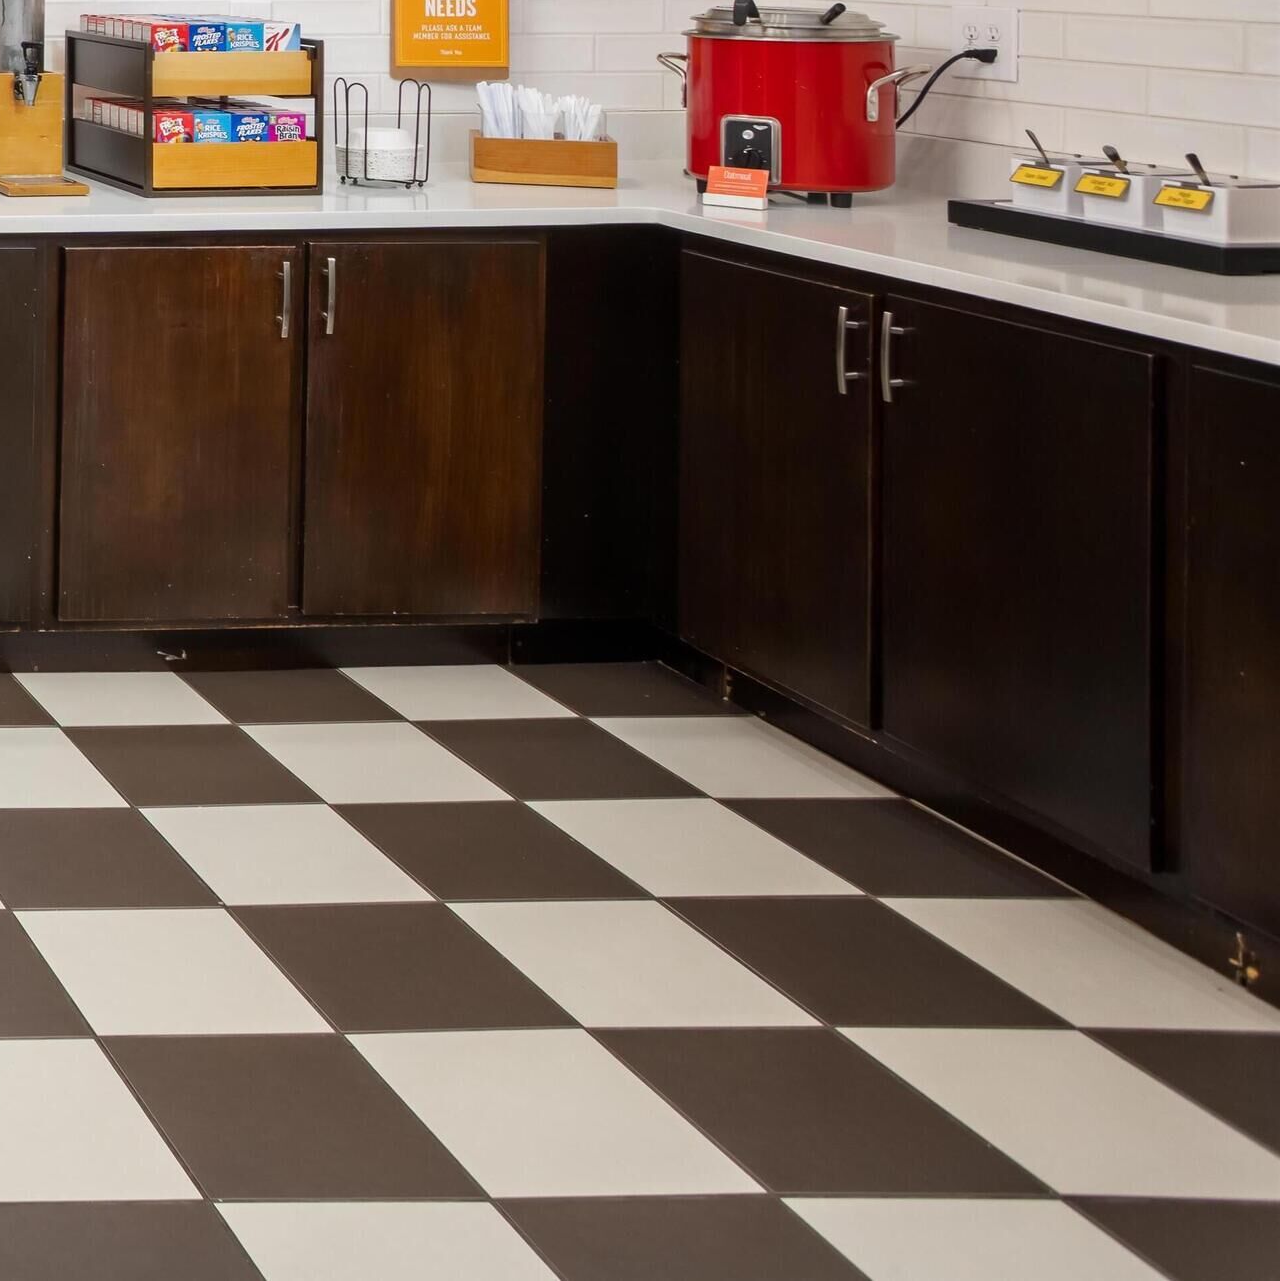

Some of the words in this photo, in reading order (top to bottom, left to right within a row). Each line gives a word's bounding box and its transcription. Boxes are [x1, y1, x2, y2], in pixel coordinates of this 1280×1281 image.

[192, 32, 221, 42] FROSTED
[194, 37, 219, 46] FLAKES
[237, 33, 254, 41] RICE
[265, 28, 290, 51] K
[230, 40, 260, 49] KRISPIES
[236, 122, 266, 132] FROSTED
[276, 125, 300, 133] Raisin
[198, 131, 228, 139] KRISPIES
[238, 129, 262, 137] FLAKES
